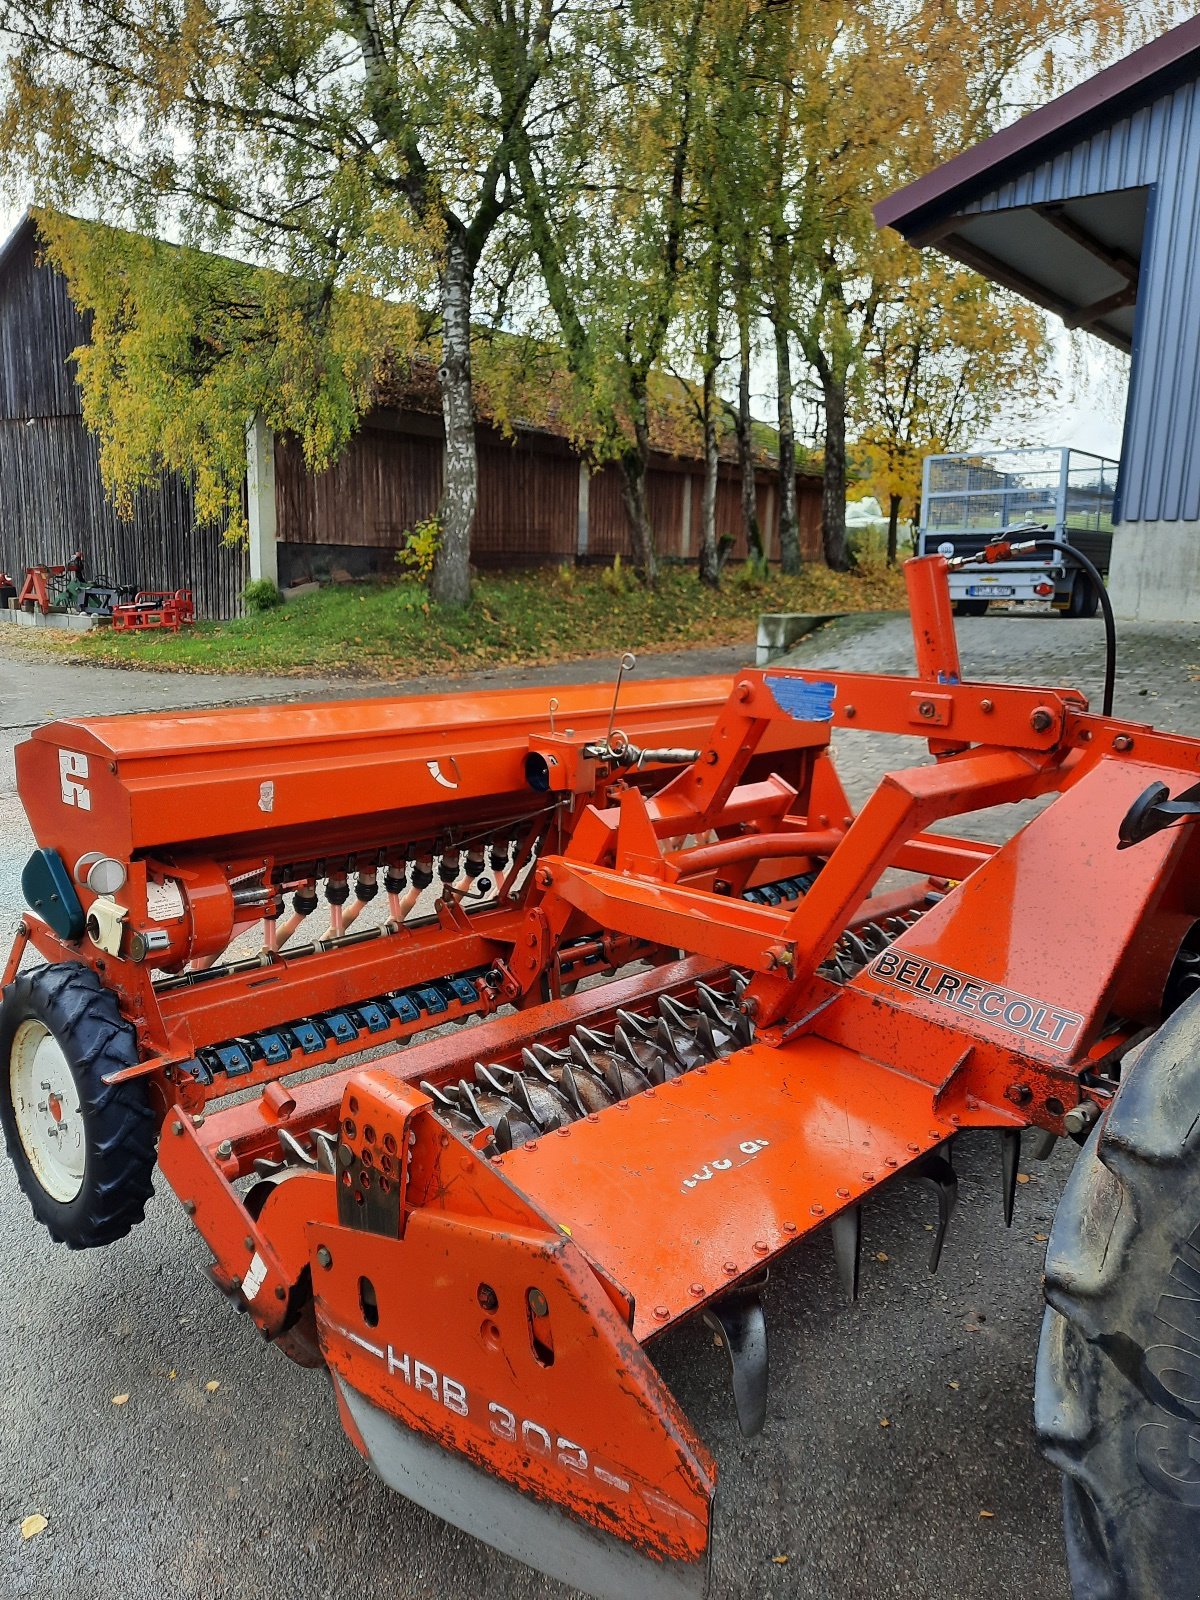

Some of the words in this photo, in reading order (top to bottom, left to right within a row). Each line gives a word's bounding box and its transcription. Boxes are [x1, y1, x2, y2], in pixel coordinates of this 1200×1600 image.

[875, 951, 1077, 1044] BELRECOLT
[387, 1344, 469, 1417] HRB
[487, 1402, 590, 1474] 302
